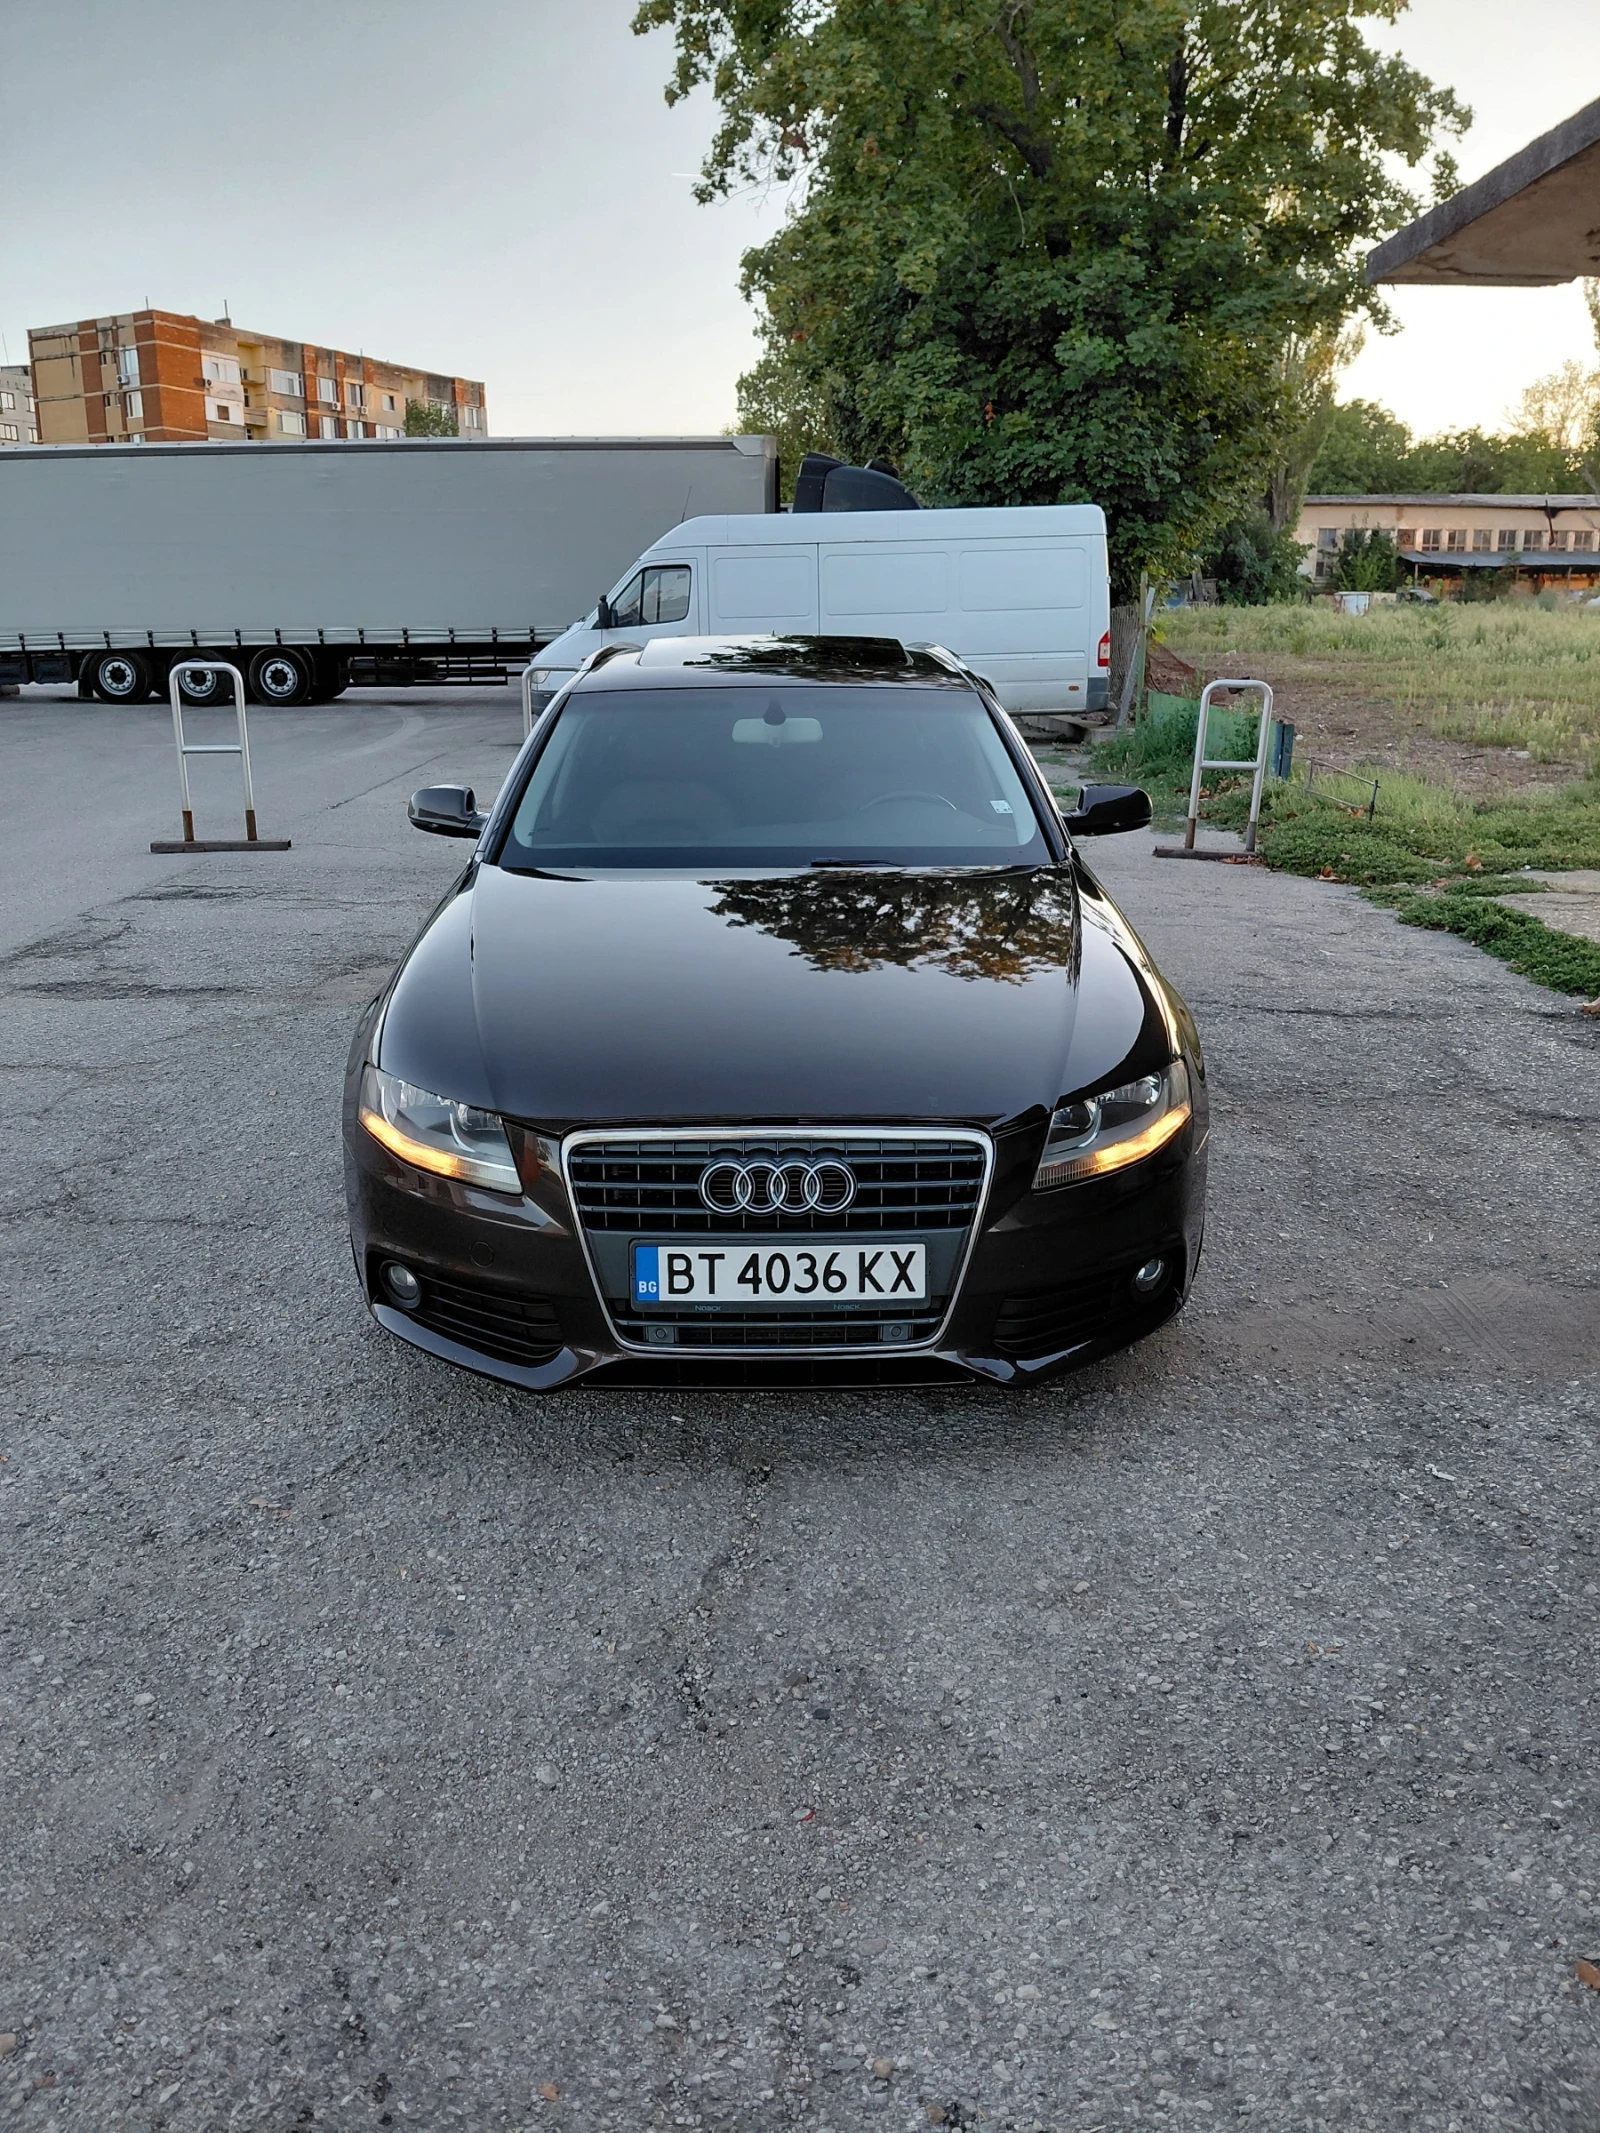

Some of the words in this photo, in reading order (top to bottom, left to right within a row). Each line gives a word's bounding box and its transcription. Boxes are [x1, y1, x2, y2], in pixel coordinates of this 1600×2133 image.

[638, 1280, 657, 1293] BG
[667, 1253, 725, 1295] BT
[737, 1252, 848, 1294] 4036
[858, 1250, 917, 1293] KX
